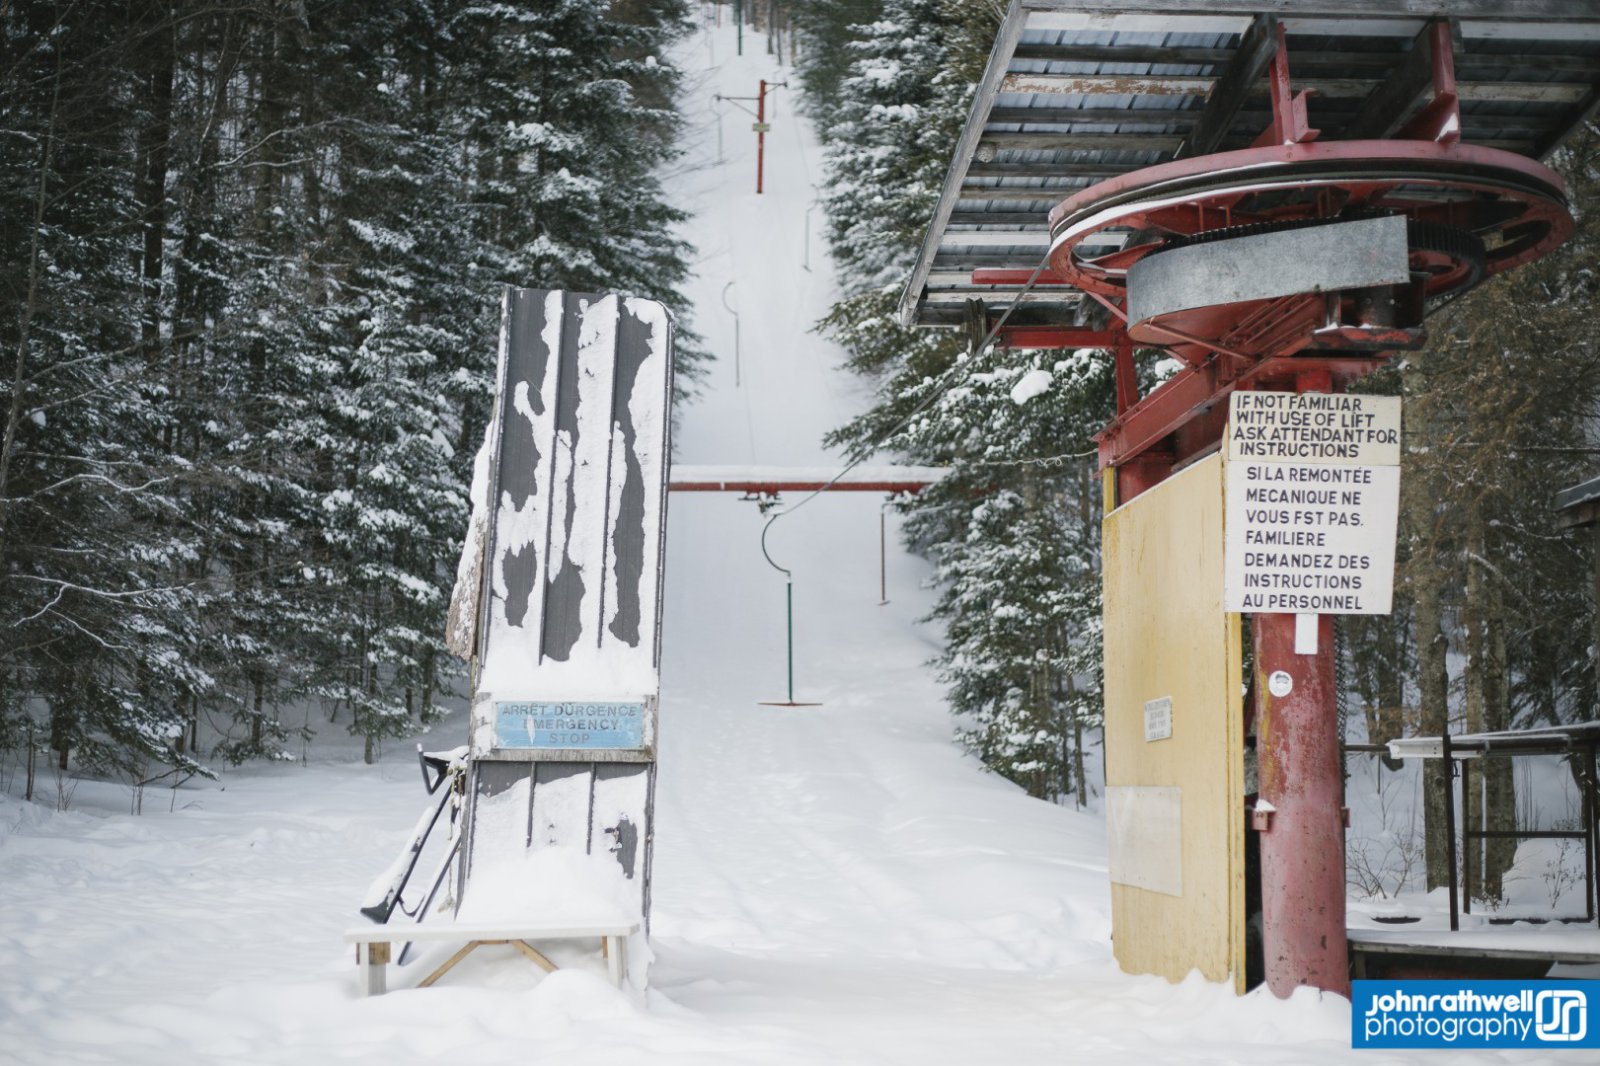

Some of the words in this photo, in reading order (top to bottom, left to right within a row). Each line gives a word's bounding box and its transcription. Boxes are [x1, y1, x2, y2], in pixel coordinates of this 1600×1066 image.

[1237, 395, 1251, 409] IF
[1254, 395, 1286, 409] NOT
[1289, 396, 1362, 411] FAMILIAR
[1236, 411, 1276, 425] WITH
[1279, 411, 1311, 427] USE
[1314, 412, 1336, 426] OF
[1341, 413, 1375, 428] LIFT
[1233, 426, 1267, 440] ASK
[1270, 427, 1364, 443] ATTENDANT
[1367, 429, 1398, 444] FOR
[1240, 442, 1359, 458] INSTRUCTIONS
[1246, 466, 1261, 480] SI
[1264, 466, 1285, 481] LA
[1289, 467, 1372, 484] REMONTÉE
[1246, 488, 1338, 505] MECANIQUE
[1341, 491, 1362, 505] NE
[1246, 509, 1290, 524] VOUS
[1246, 530, 1326, 547] FAMILIERE
[1244, 552, 1333, 568] DEMANDEZ
[1338, 555, 1370, 569] DES
[1244, 573, 1362, 589] INSTRUCTIONS
[1242, 594, 1264, 608] AU
[1268, 594, 1363, 610] PERSONNEL
[549, 732, 591, 744] STOP
